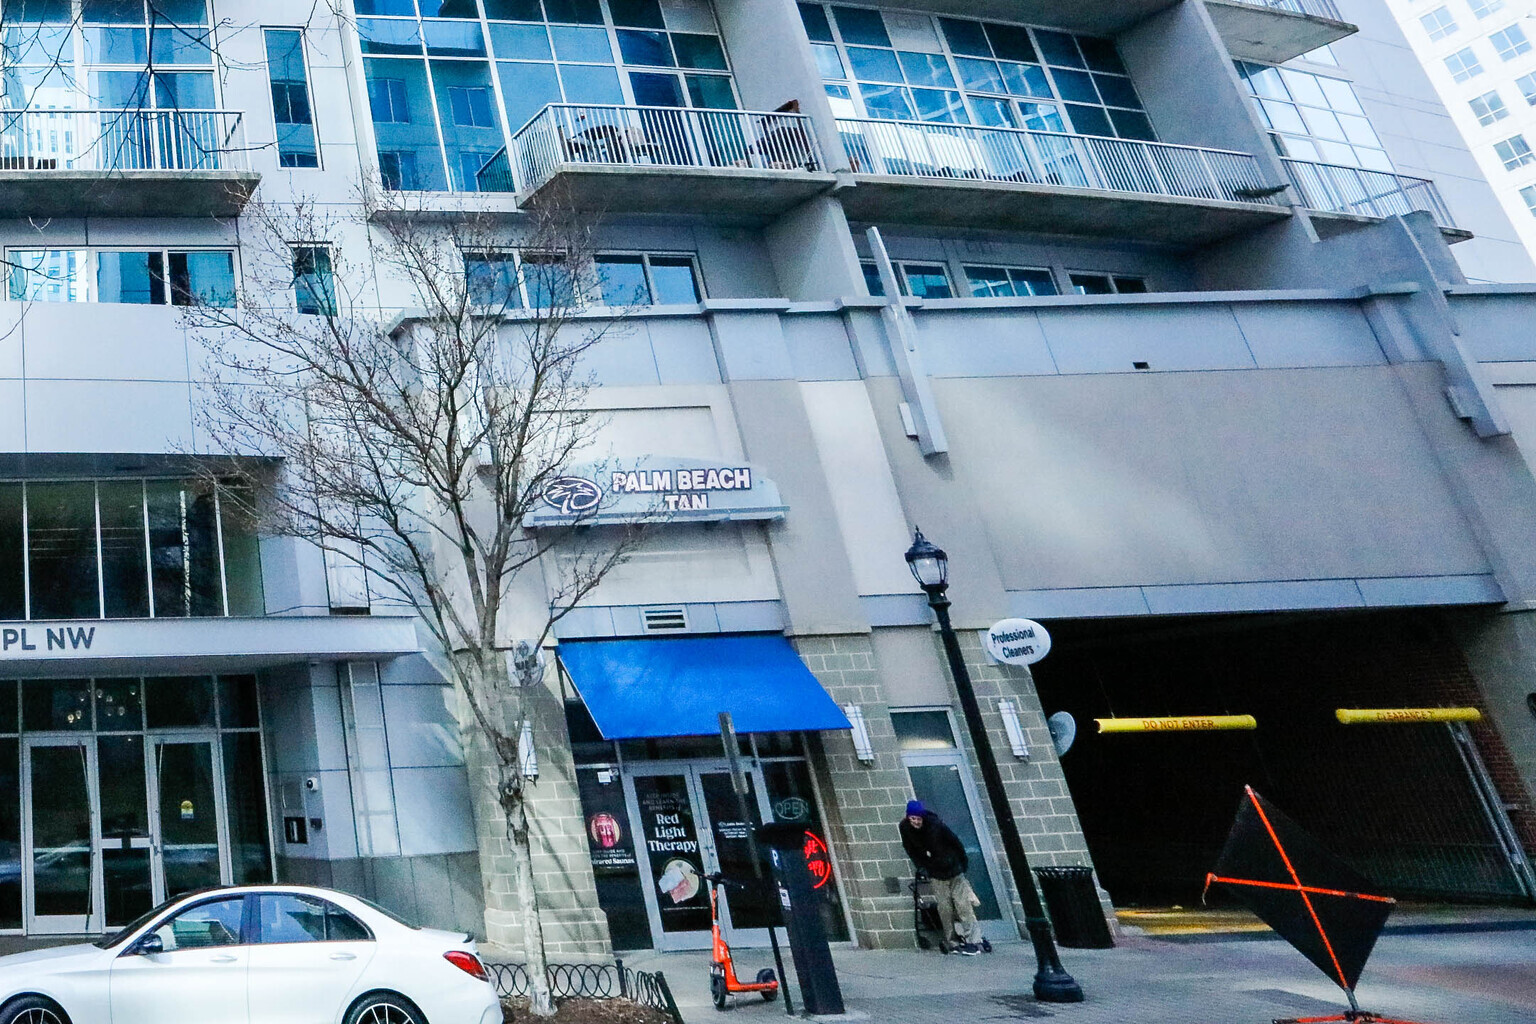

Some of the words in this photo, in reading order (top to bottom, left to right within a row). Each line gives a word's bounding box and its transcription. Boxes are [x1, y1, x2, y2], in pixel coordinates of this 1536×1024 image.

[612, 470, 672, 493] PALM
[675, 467, 752, 491] BEACH
[664, 493, 710, 511] TAN
[2, 628, 37, 651] PL
[47, 626, 96, 651] NW
[990, 626, 1036, 645] Professional
[1002, 645, 1035, 659] Cleaners
[1142, 720, 1158, 729] DO
[1159, 720, 1180, 729] NOT
[1182, 719, 1214, 729] ENTER
[774, 801, 810, 816] OPEN
[655, 813, 680, 825] Red
[654, 826, 687, 840] Light
[647, 840, 698, 853] Therapy
